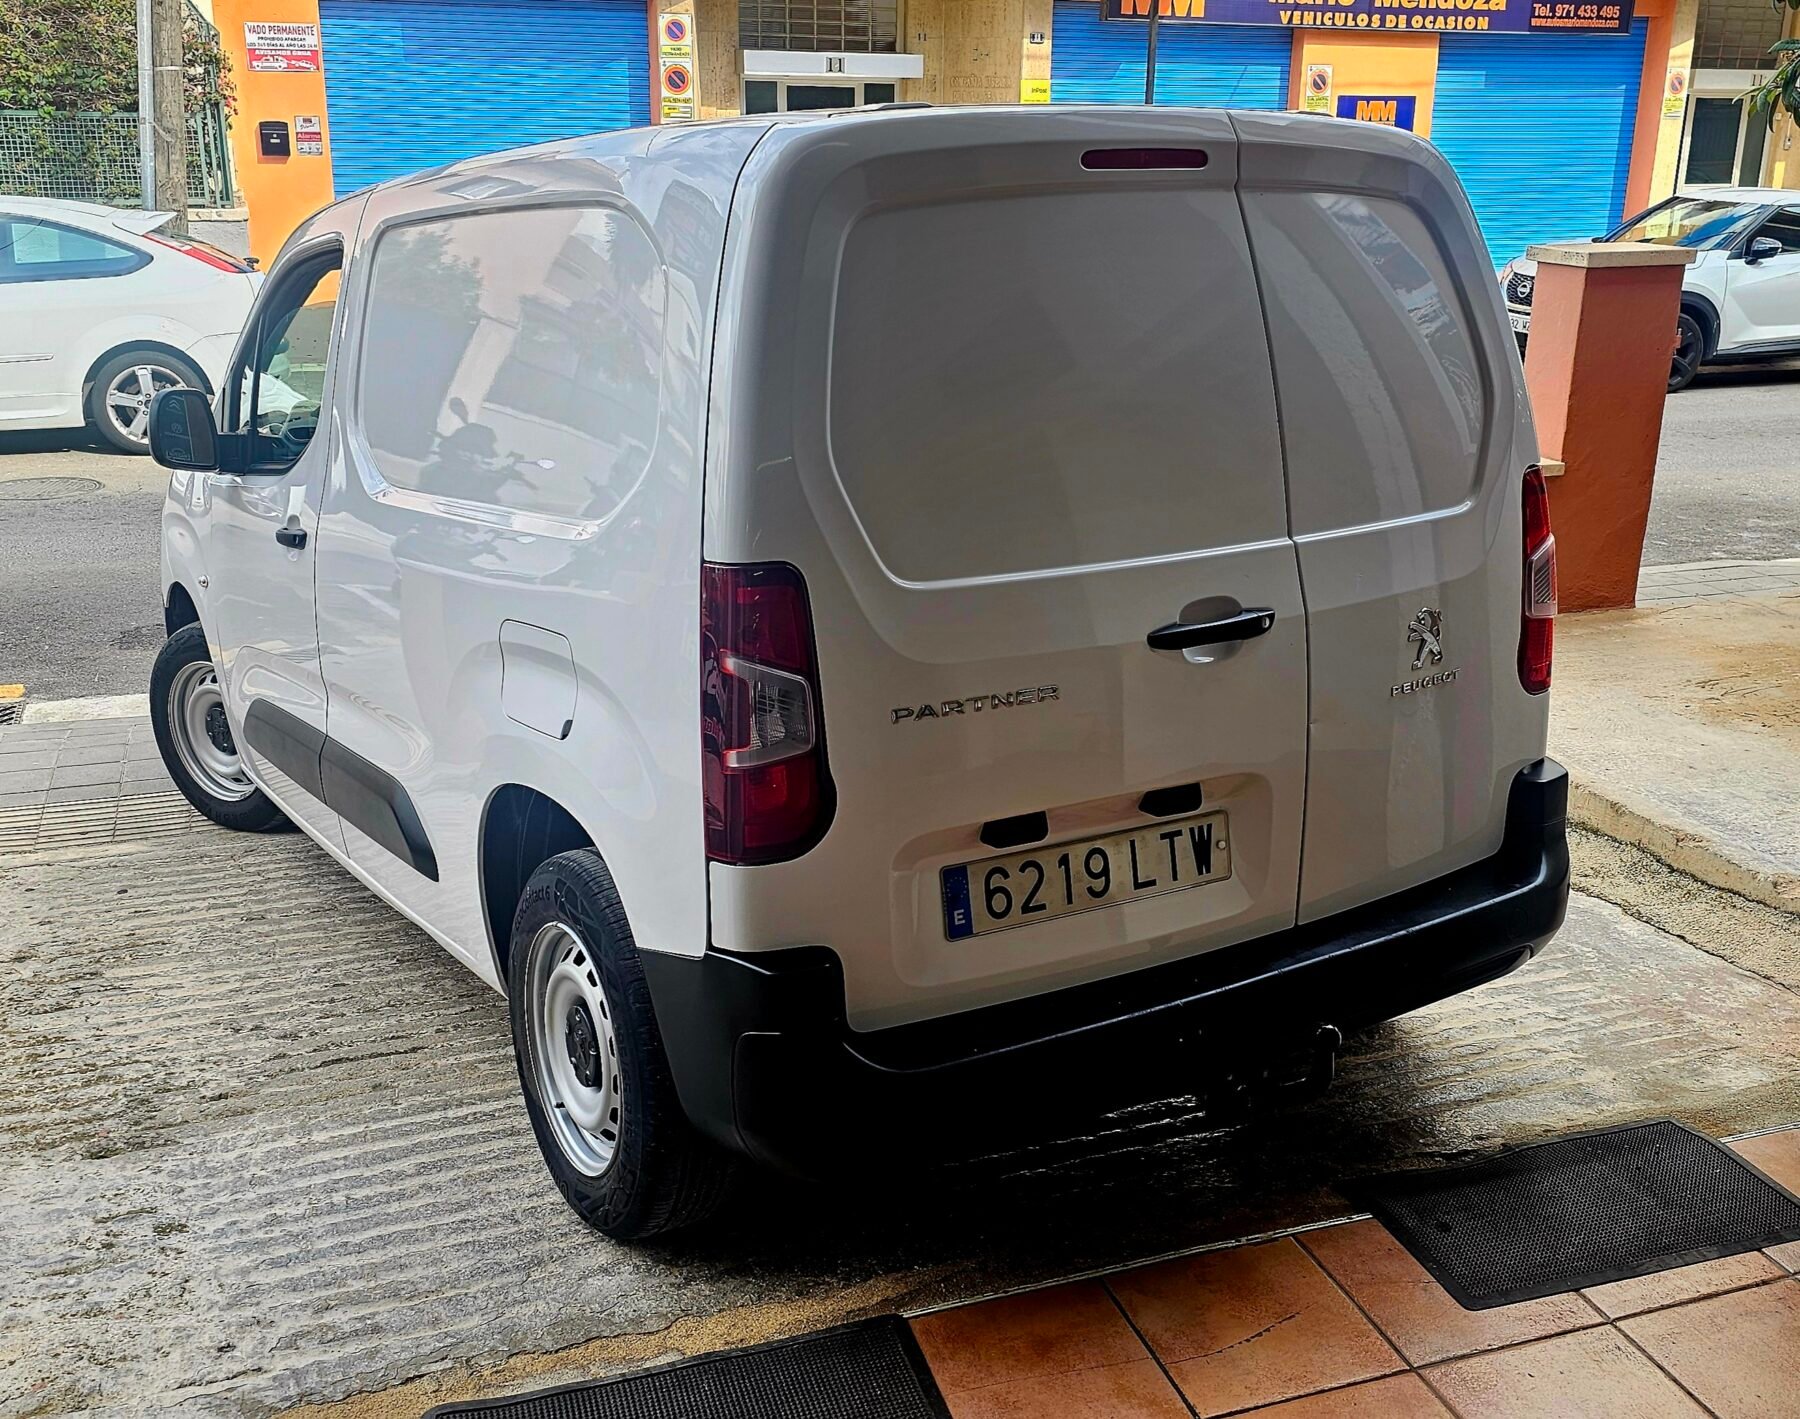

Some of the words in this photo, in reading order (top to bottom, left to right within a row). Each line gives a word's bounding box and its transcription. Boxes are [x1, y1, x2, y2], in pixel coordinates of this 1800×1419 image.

[1279, 10, 1381, 28] VEHICULOS
[1385, 14, 1407, 29] DE
[1411, 15, 1489, 30] OCASION
[1533, 3, 1553, 17] Tel.
[1555, 4, 1575, 17] 971
[1577, 5, 1598, 18] 433
[1599, 5, 1620, 18] 495
[247, 24, 266, 35] VADO
[268, 25, 315, 36] PERMANENTE
[828, 57, 842, 72] 11
[1356, 100, 1397, 122] MM
[1390, 667, 1461, 697] PEUGEOT
[890, 684, 1061, 725] PARTNER
[983, 846, 1111, 921] 6219
[1128, 822, 1213, 891] LTW
[953, 909, 966, 925] E
